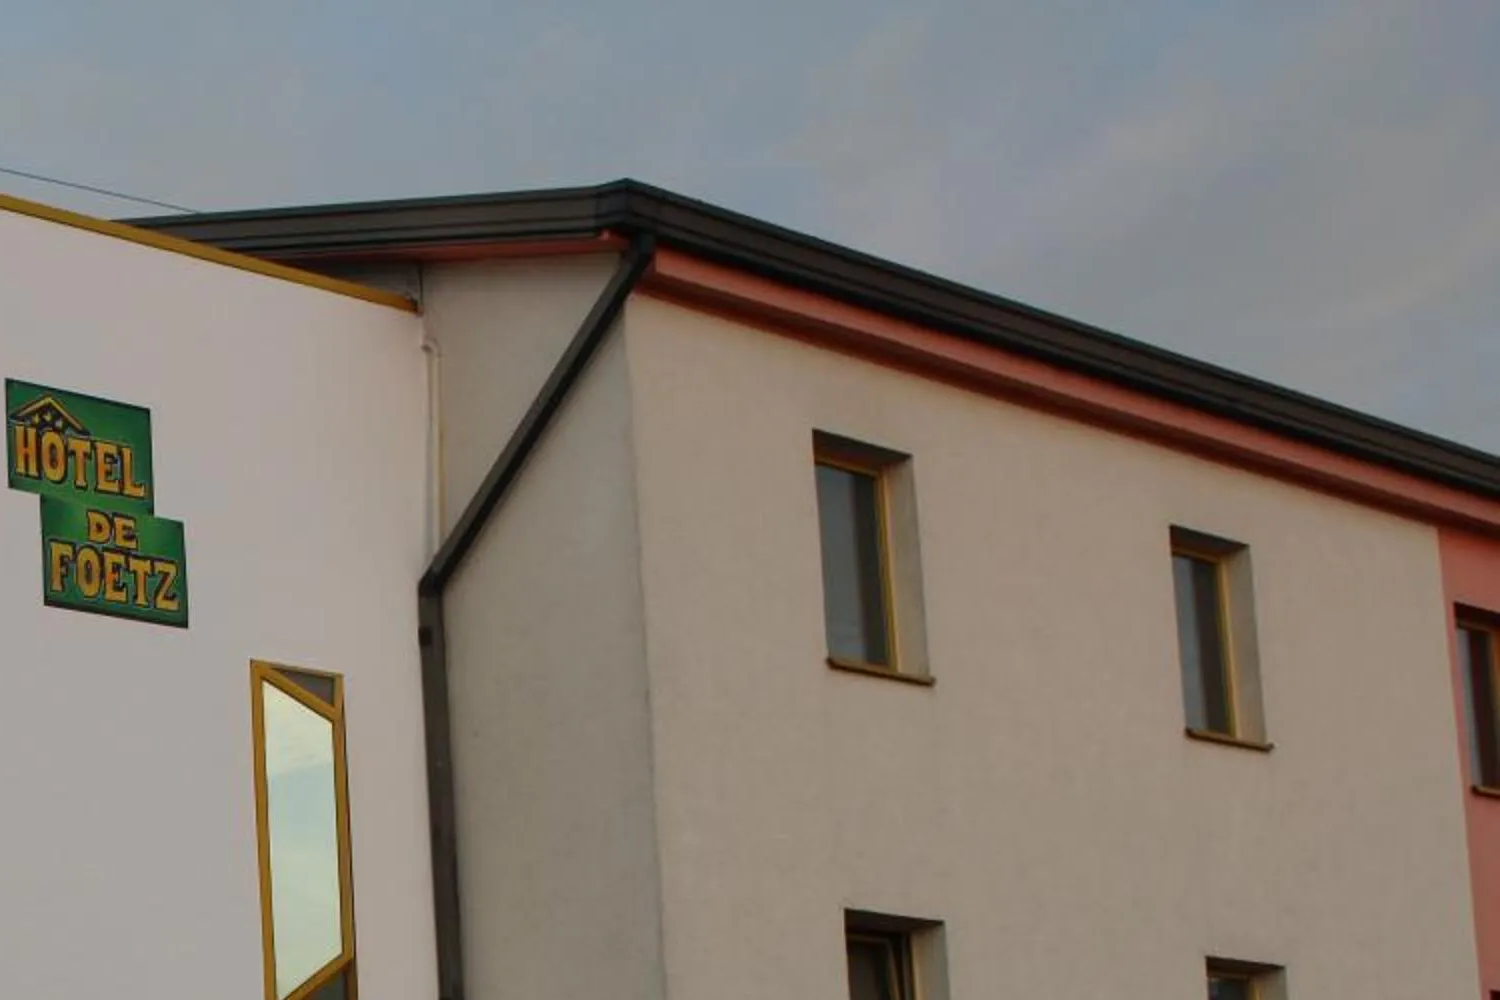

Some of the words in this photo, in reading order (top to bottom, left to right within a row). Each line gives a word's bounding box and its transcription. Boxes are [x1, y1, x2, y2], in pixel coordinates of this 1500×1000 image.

[14, 423, 146, 498] HOTEL
[88, 511, 138, 549] DE
[50, 542, 180, 612] FOETZ
